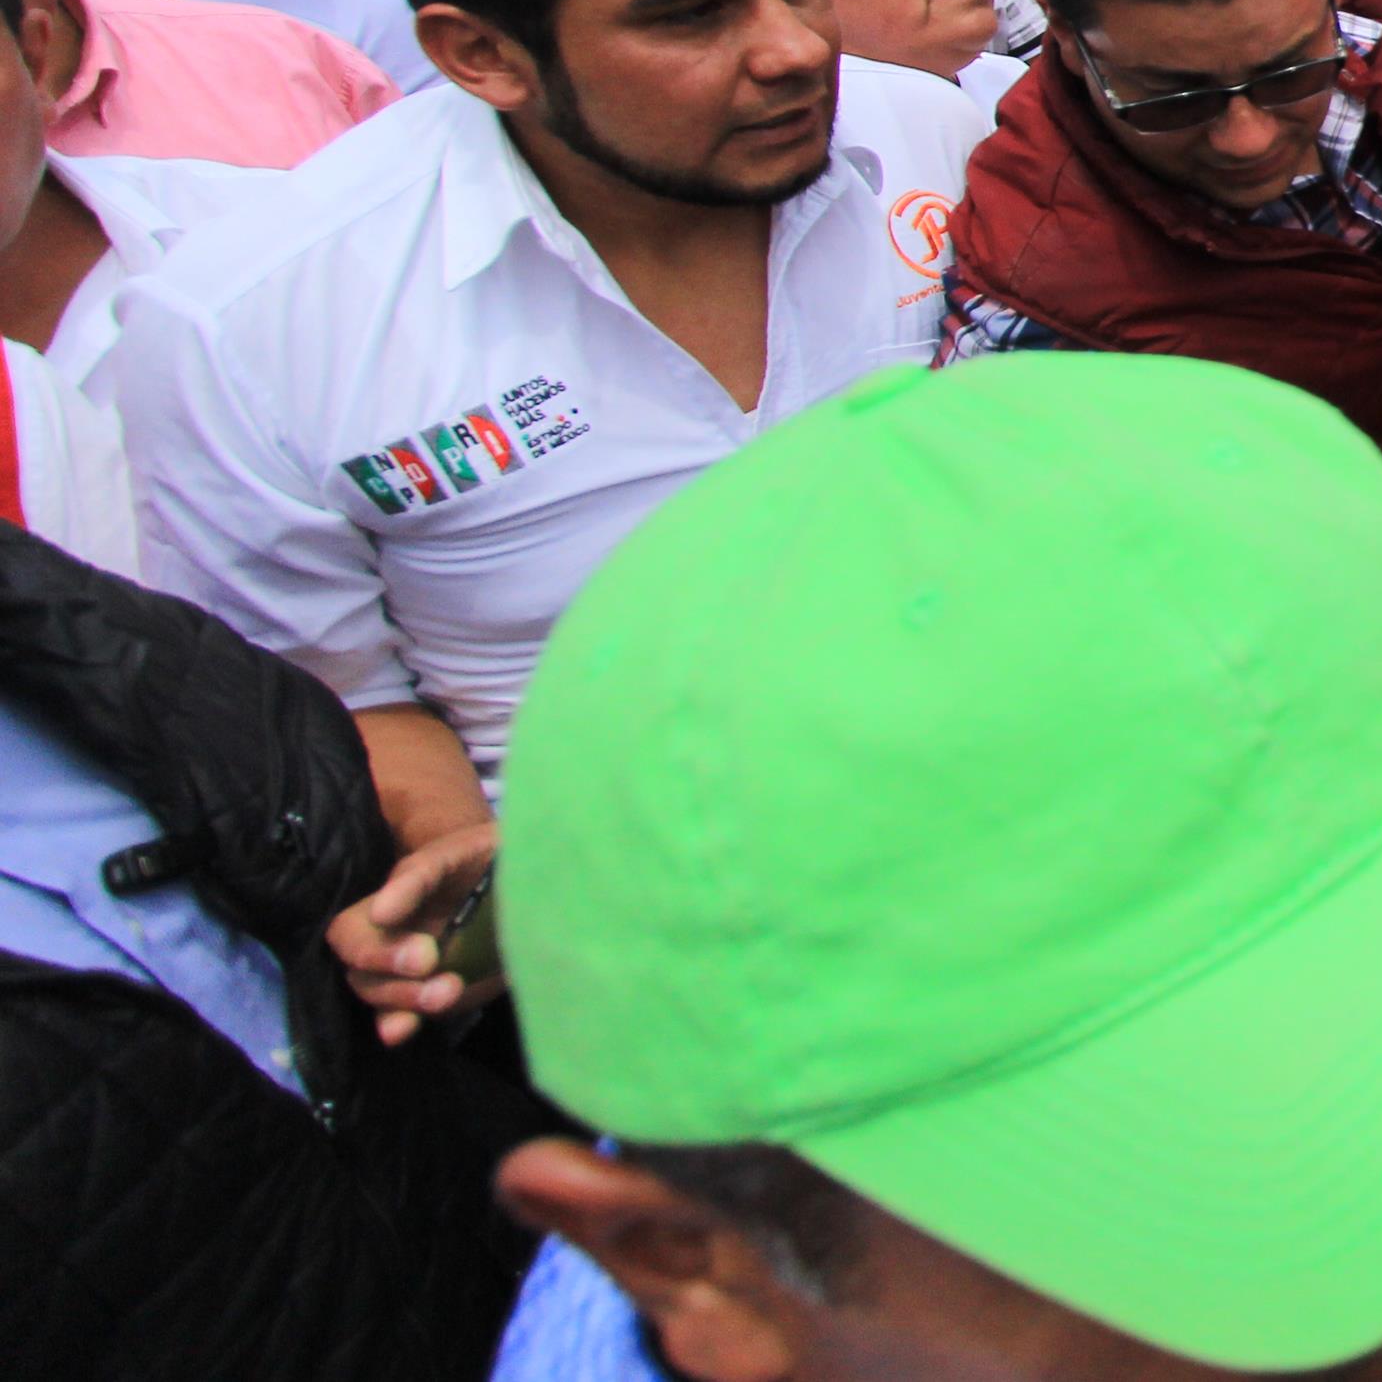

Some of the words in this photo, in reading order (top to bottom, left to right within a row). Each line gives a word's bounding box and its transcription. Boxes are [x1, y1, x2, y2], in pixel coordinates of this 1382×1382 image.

[896, 284, 945, 309] Juvent
[500, 375, 549, 408] JUNTOS
[504, 381, 567, 418] HACEMOS
[443, 423, 503, 474] PRI
